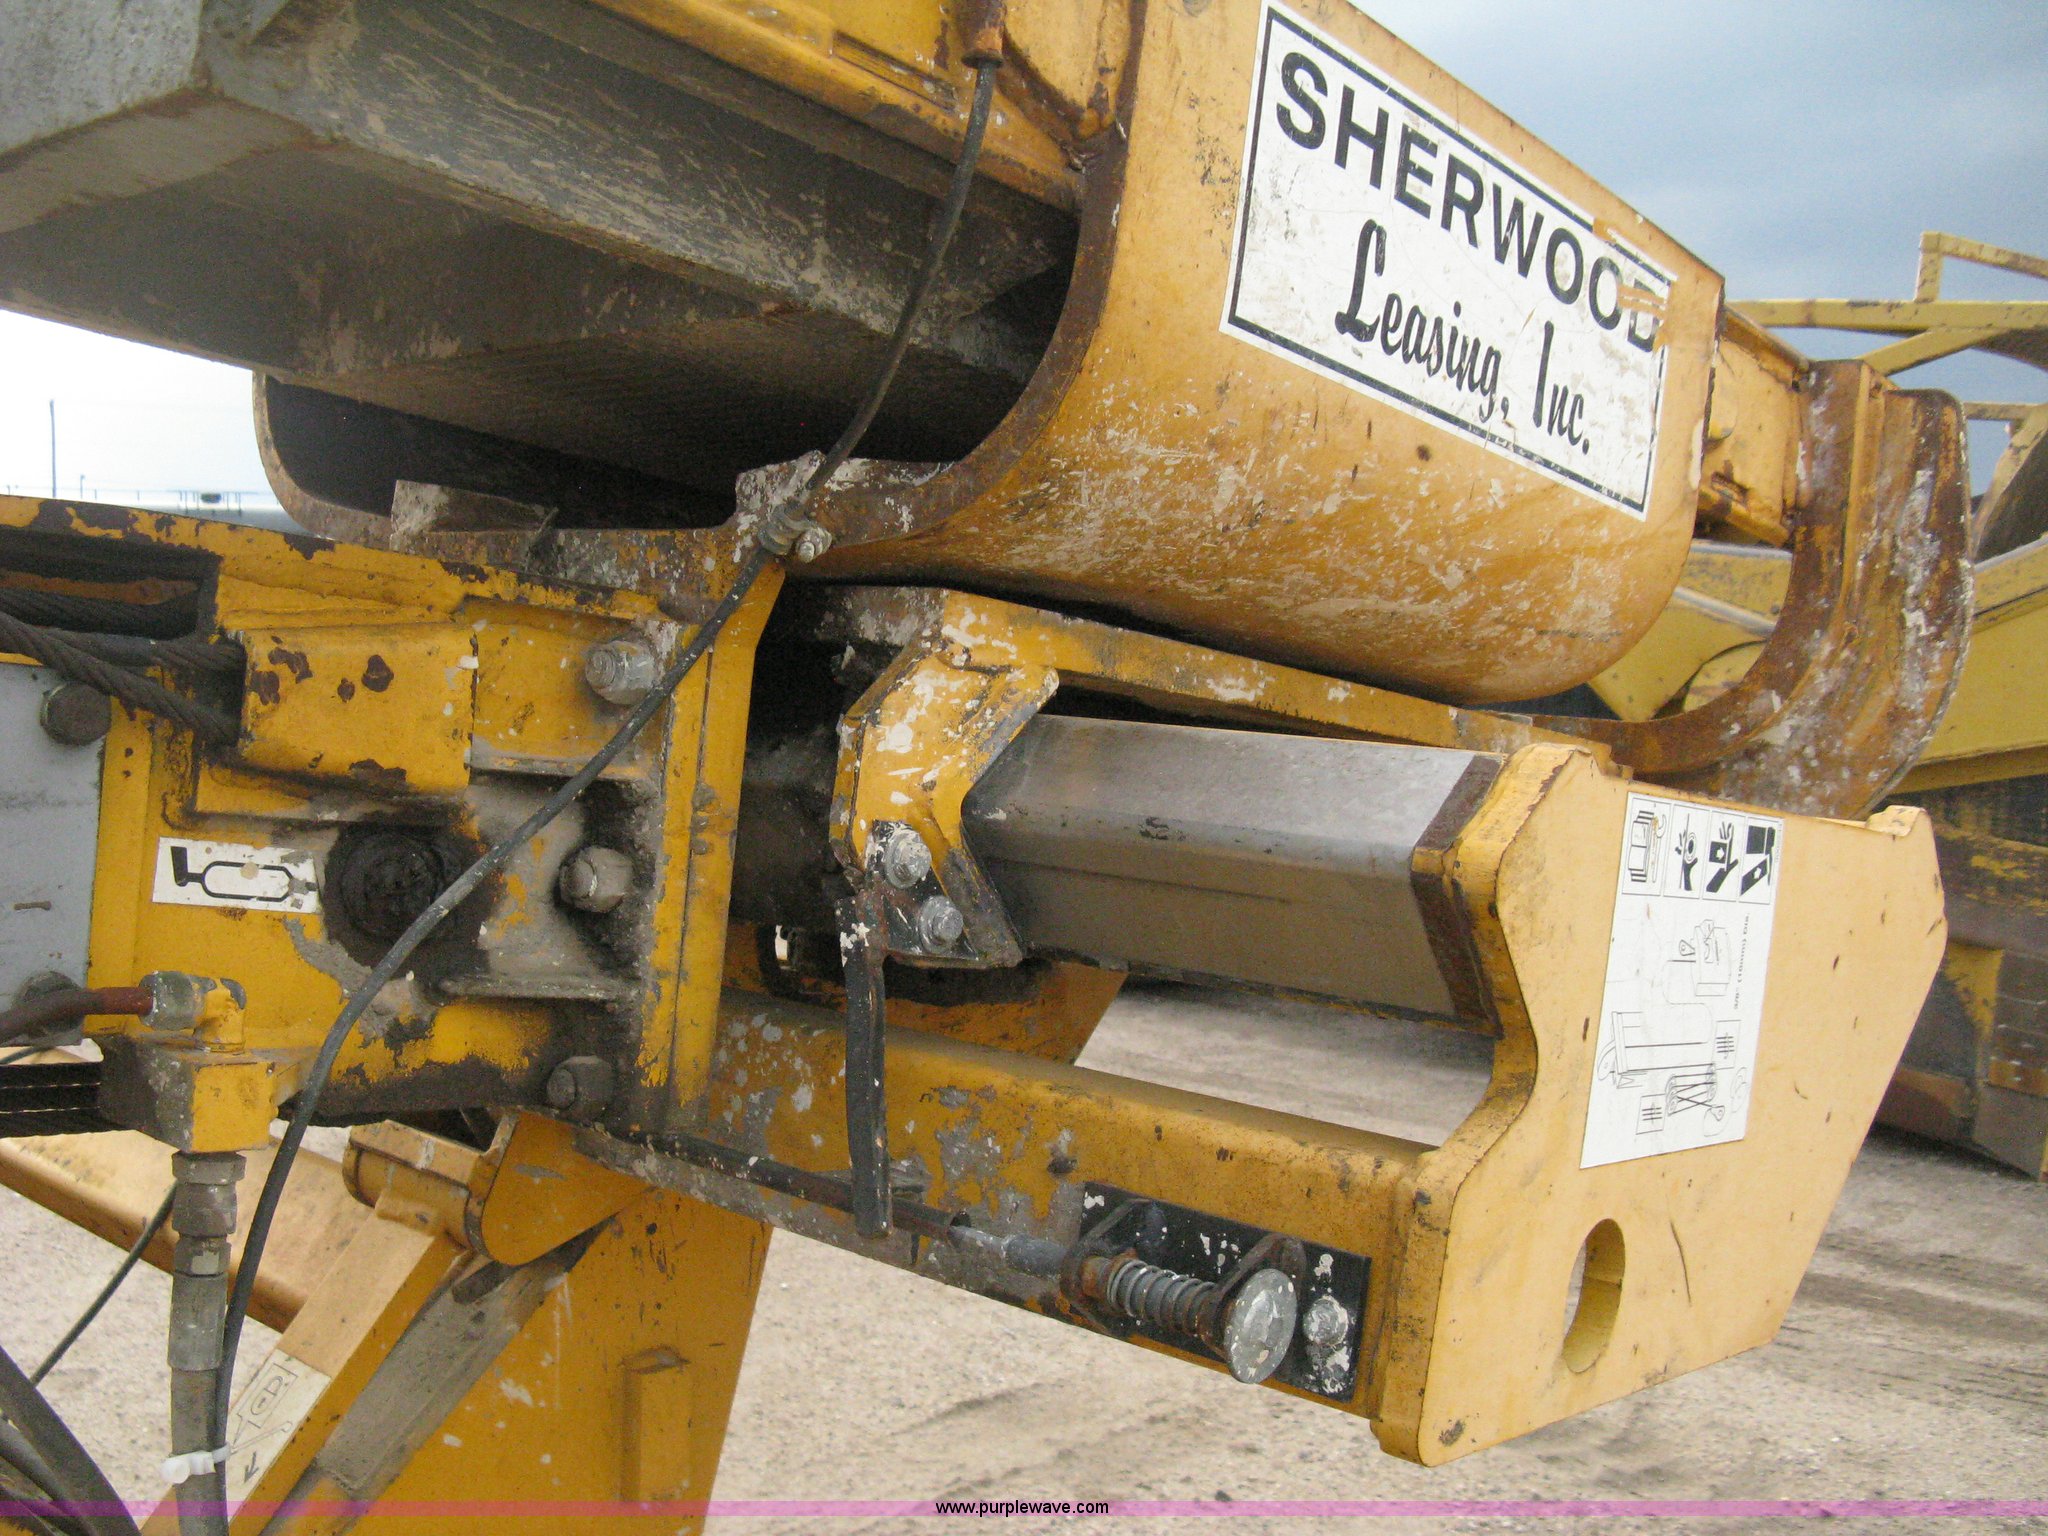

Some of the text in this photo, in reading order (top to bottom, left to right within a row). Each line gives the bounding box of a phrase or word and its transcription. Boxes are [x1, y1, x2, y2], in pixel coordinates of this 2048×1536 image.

[1276, 51, 1662, 353] SHERWOOD
[1334, 218, 1590, 455] Leasing, Inc.
